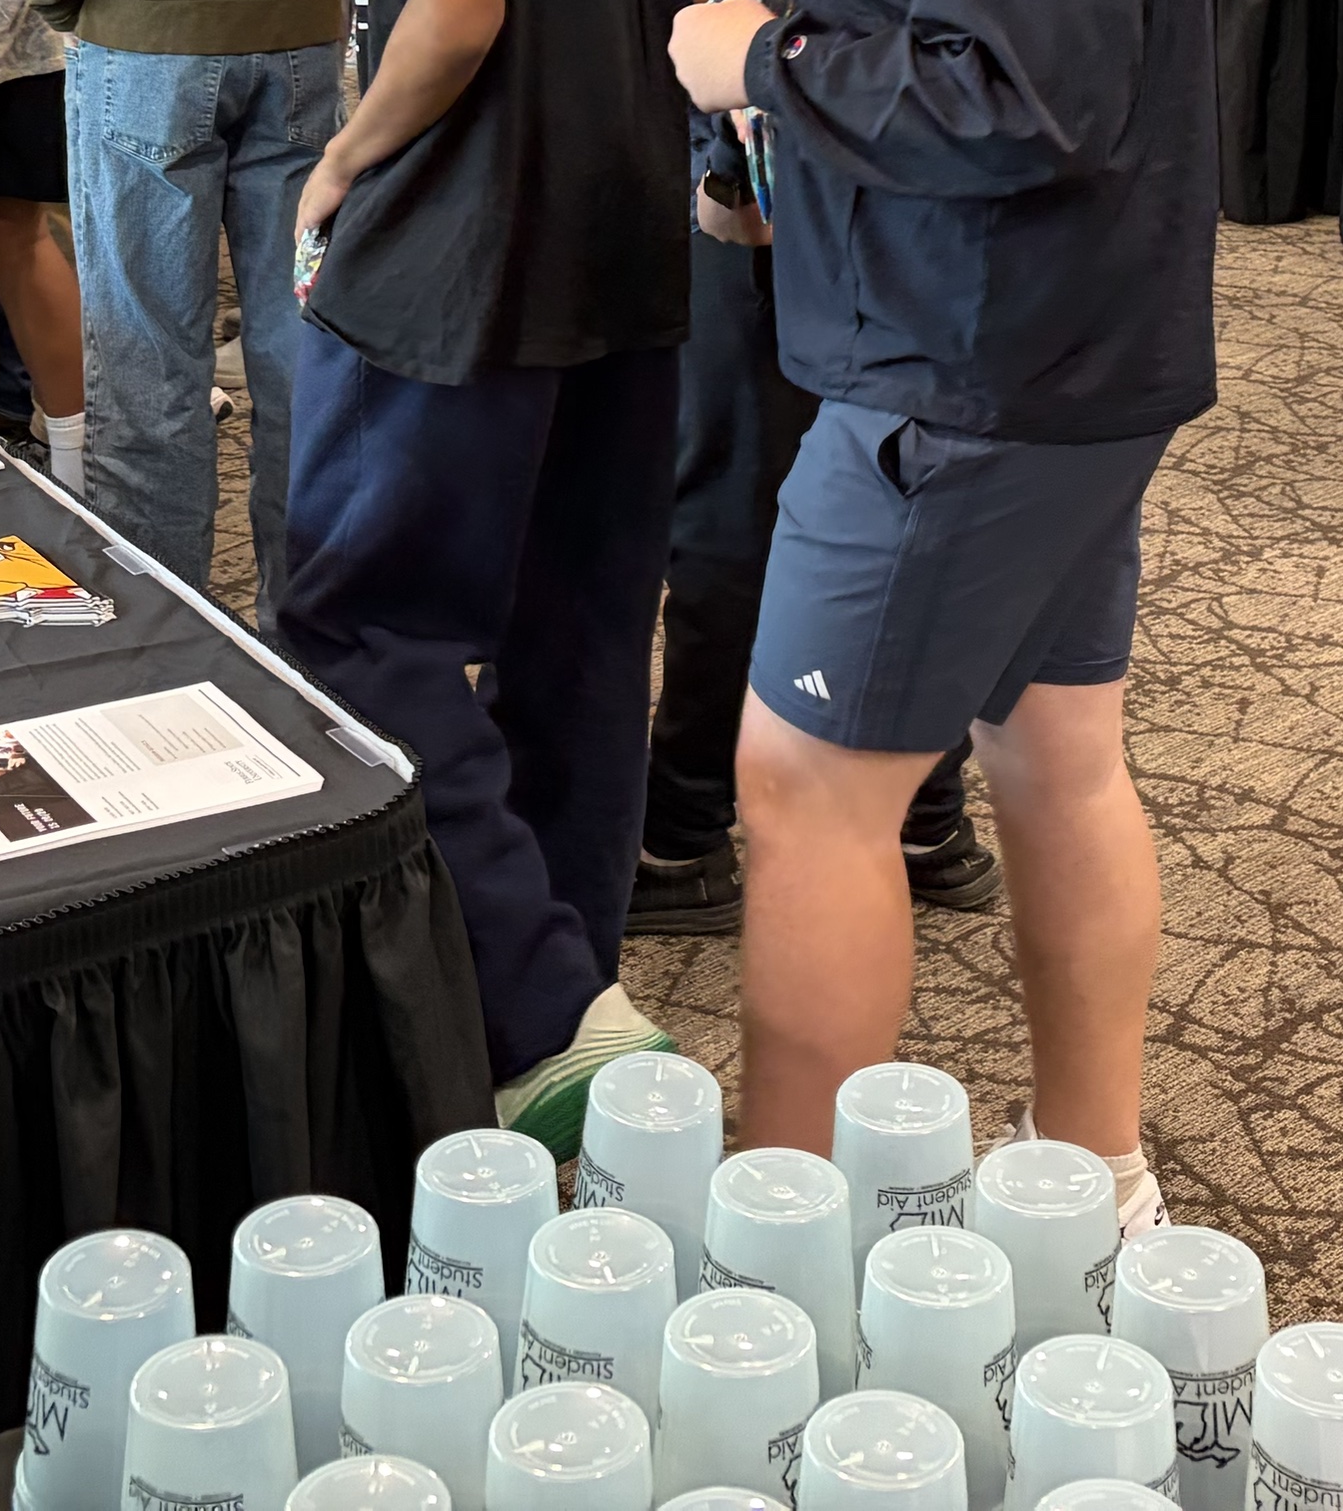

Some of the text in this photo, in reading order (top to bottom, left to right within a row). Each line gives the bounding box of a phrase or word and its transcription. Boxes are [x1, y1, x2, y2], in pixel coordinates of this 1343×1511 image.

[877, 1193, 909, 1212] Aid
[418, 1251, 483, 1289] Student
[1084, 1267, 1109, 1293] Aid
[537, 1348, 614, 1380] Student
[983, 1358, 1007, 1388] Aid
[768, 1434, 798, 1464] Aid
